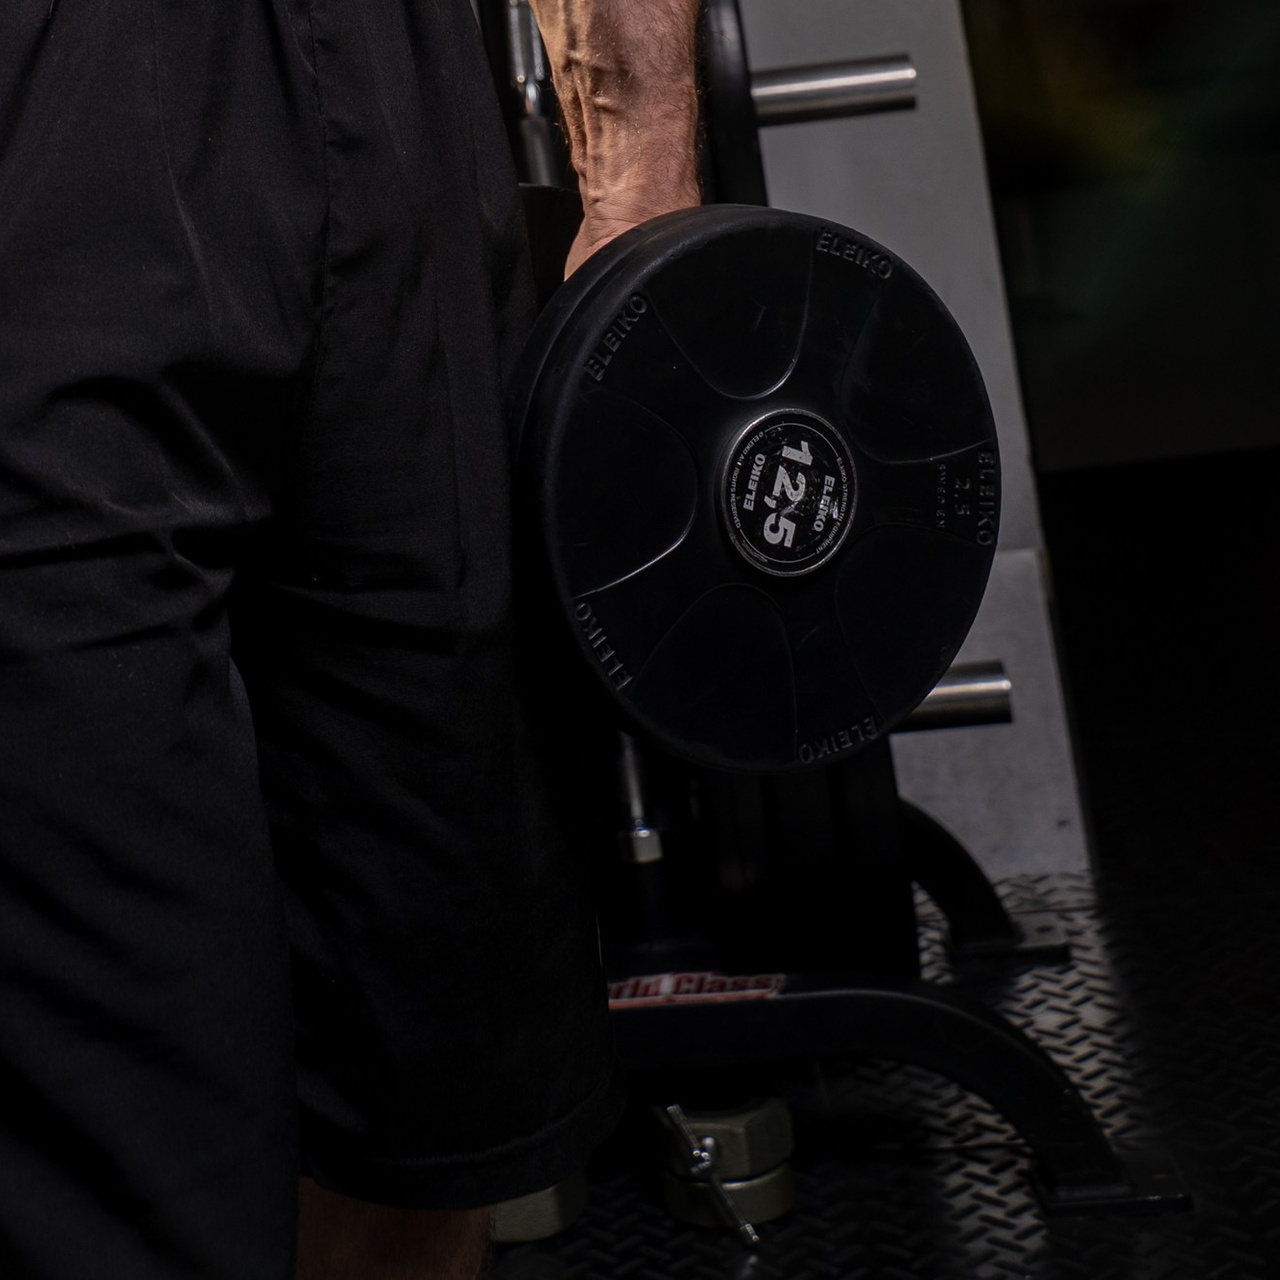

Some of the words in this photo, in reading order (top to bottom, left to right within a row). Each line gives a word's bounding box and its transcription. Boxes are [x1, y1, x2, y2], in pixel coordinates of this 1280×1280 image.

[584, 292, 648, 382] ELEIKO
[742, 453, 766, 511] ELEIKO
[763, 440, 813, 548] 12,5
[813, 474, 836, 532] ELEIKO
